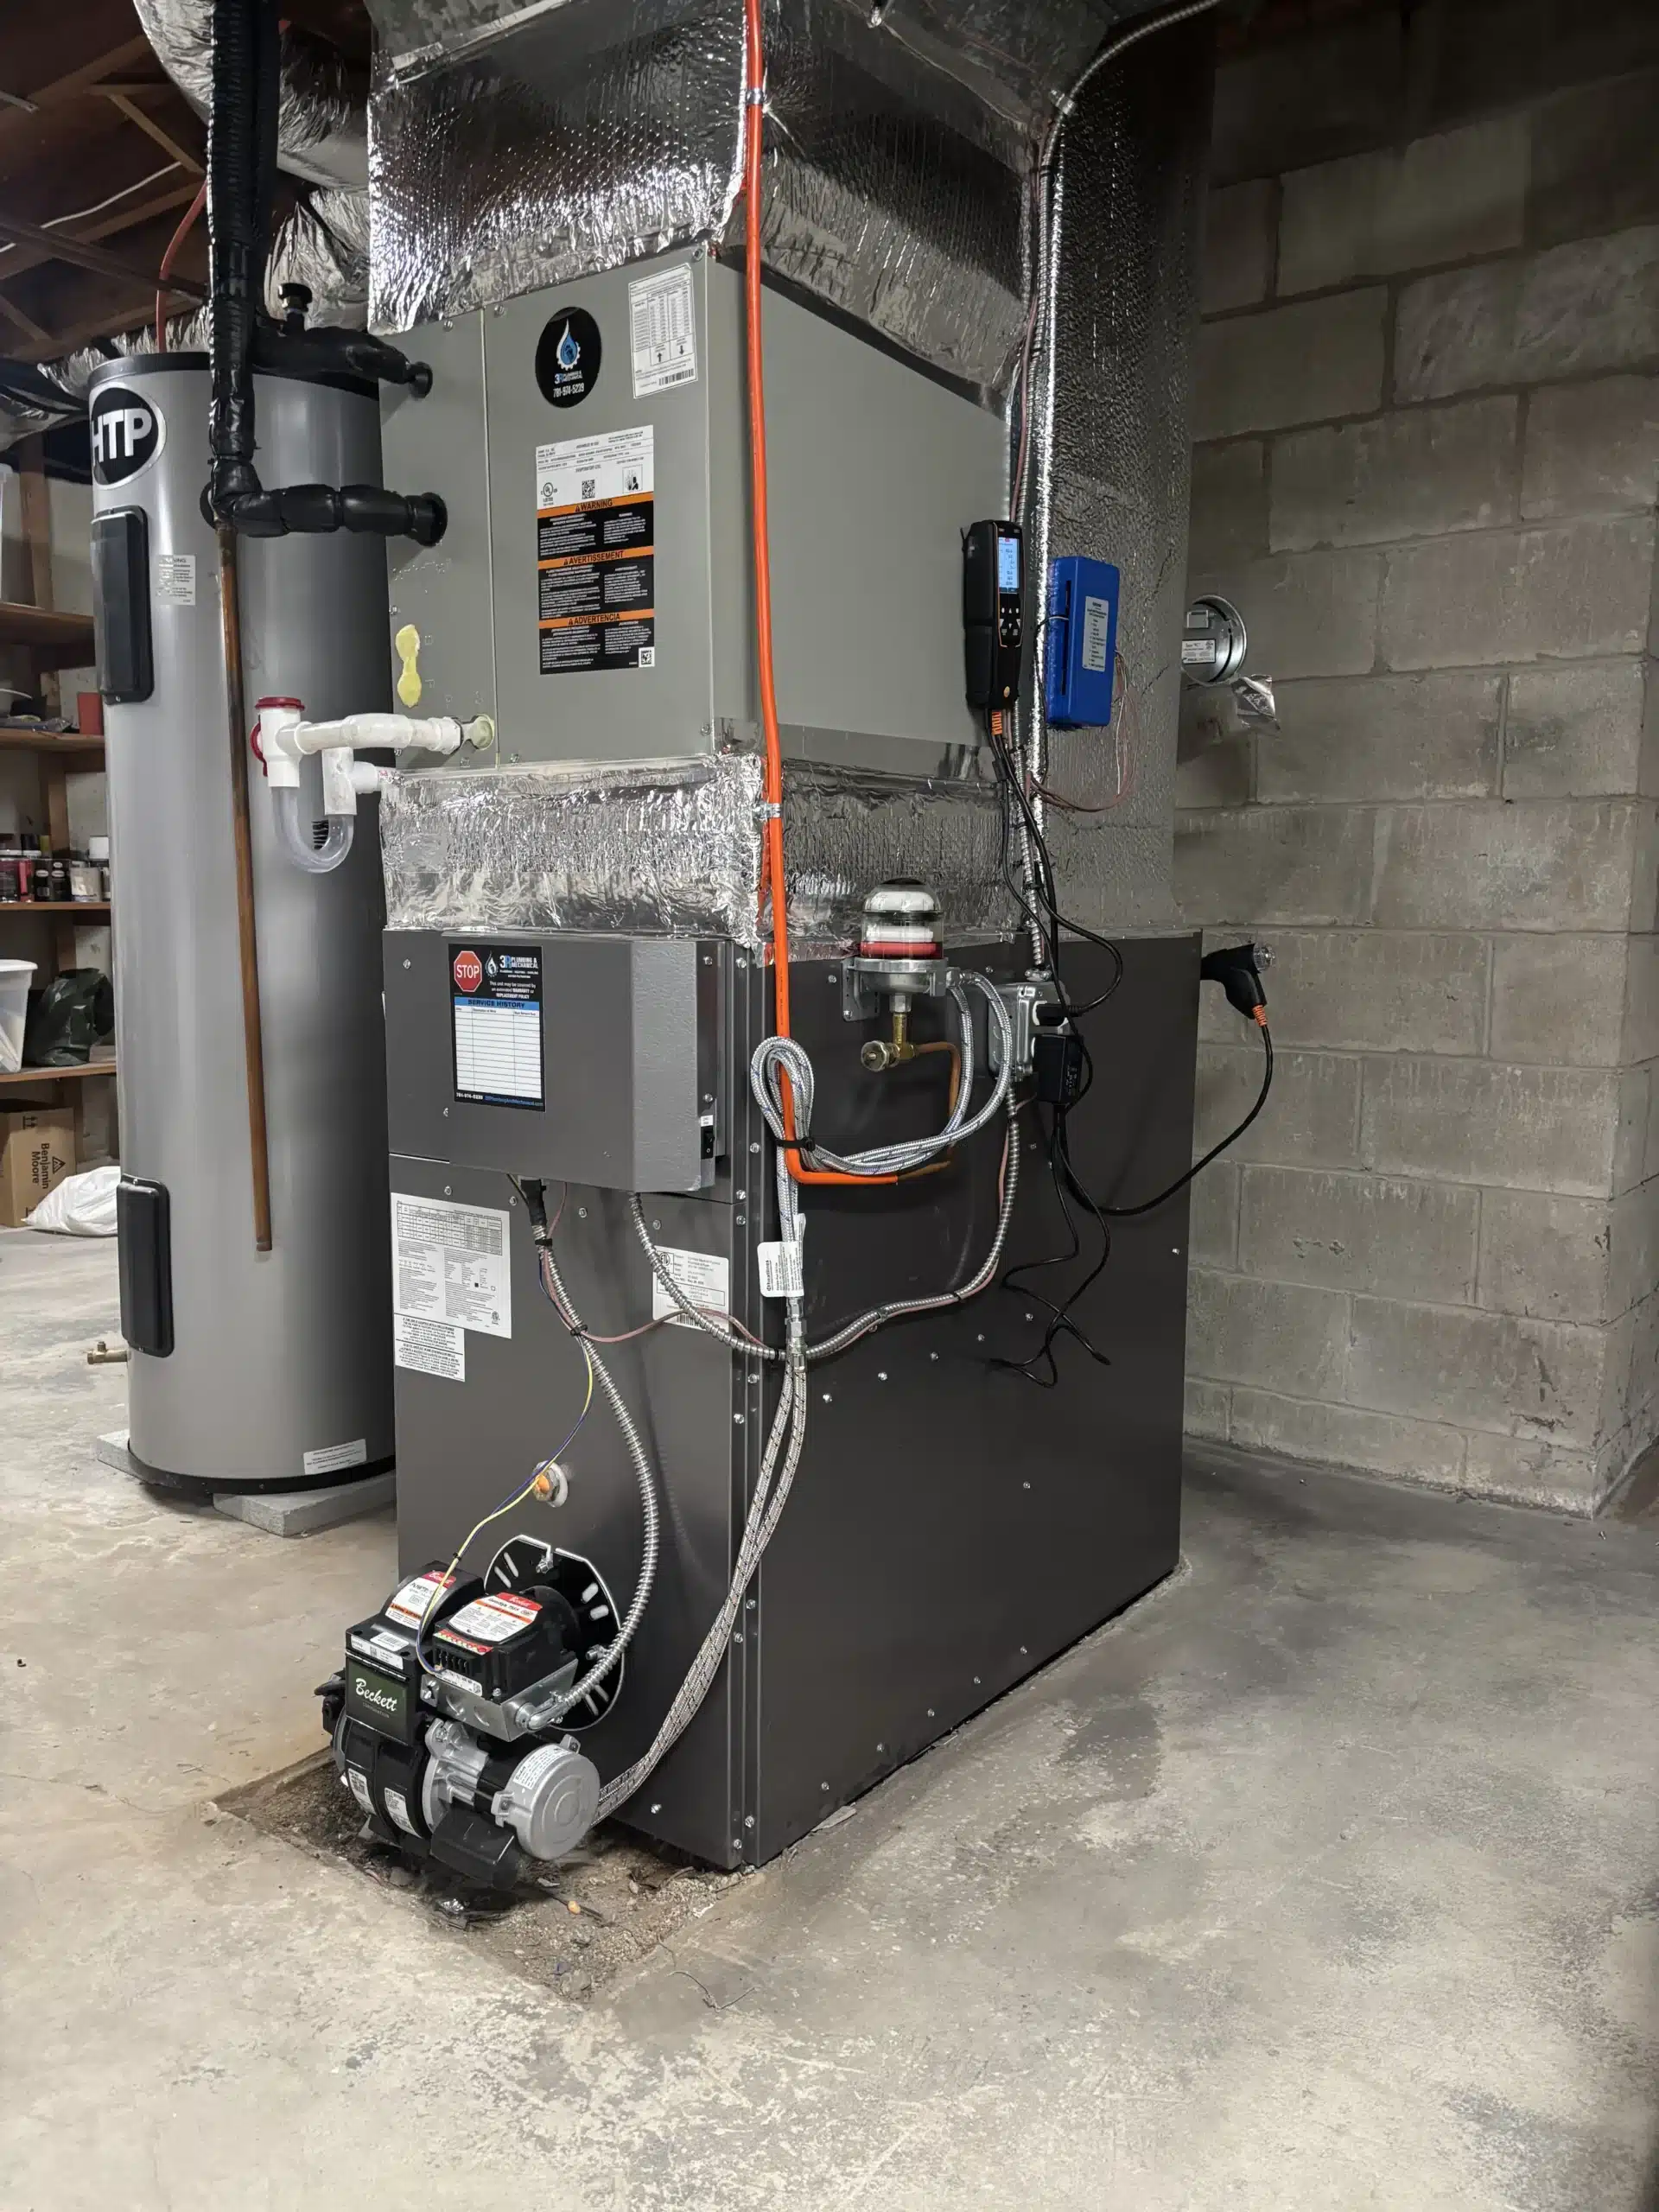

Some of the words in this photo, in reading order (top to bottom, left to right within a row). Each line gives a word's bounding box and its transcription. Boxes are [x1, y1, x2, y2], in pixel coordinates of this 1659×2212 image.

[92, 408, 152, 467] HTP
[581, 499, 613, 511] WARNING
[569, 550, 624, 564] AVERTISSEMENT
[575, 613, 620, 625] ADVERTENCIA
[456, 964, 480, 978] STOP
[31, 1151, 41, 1184] Moore
[40, 1143, 51, 1189] Benjamin
[355, 1677, 397, 1711] Beckett
